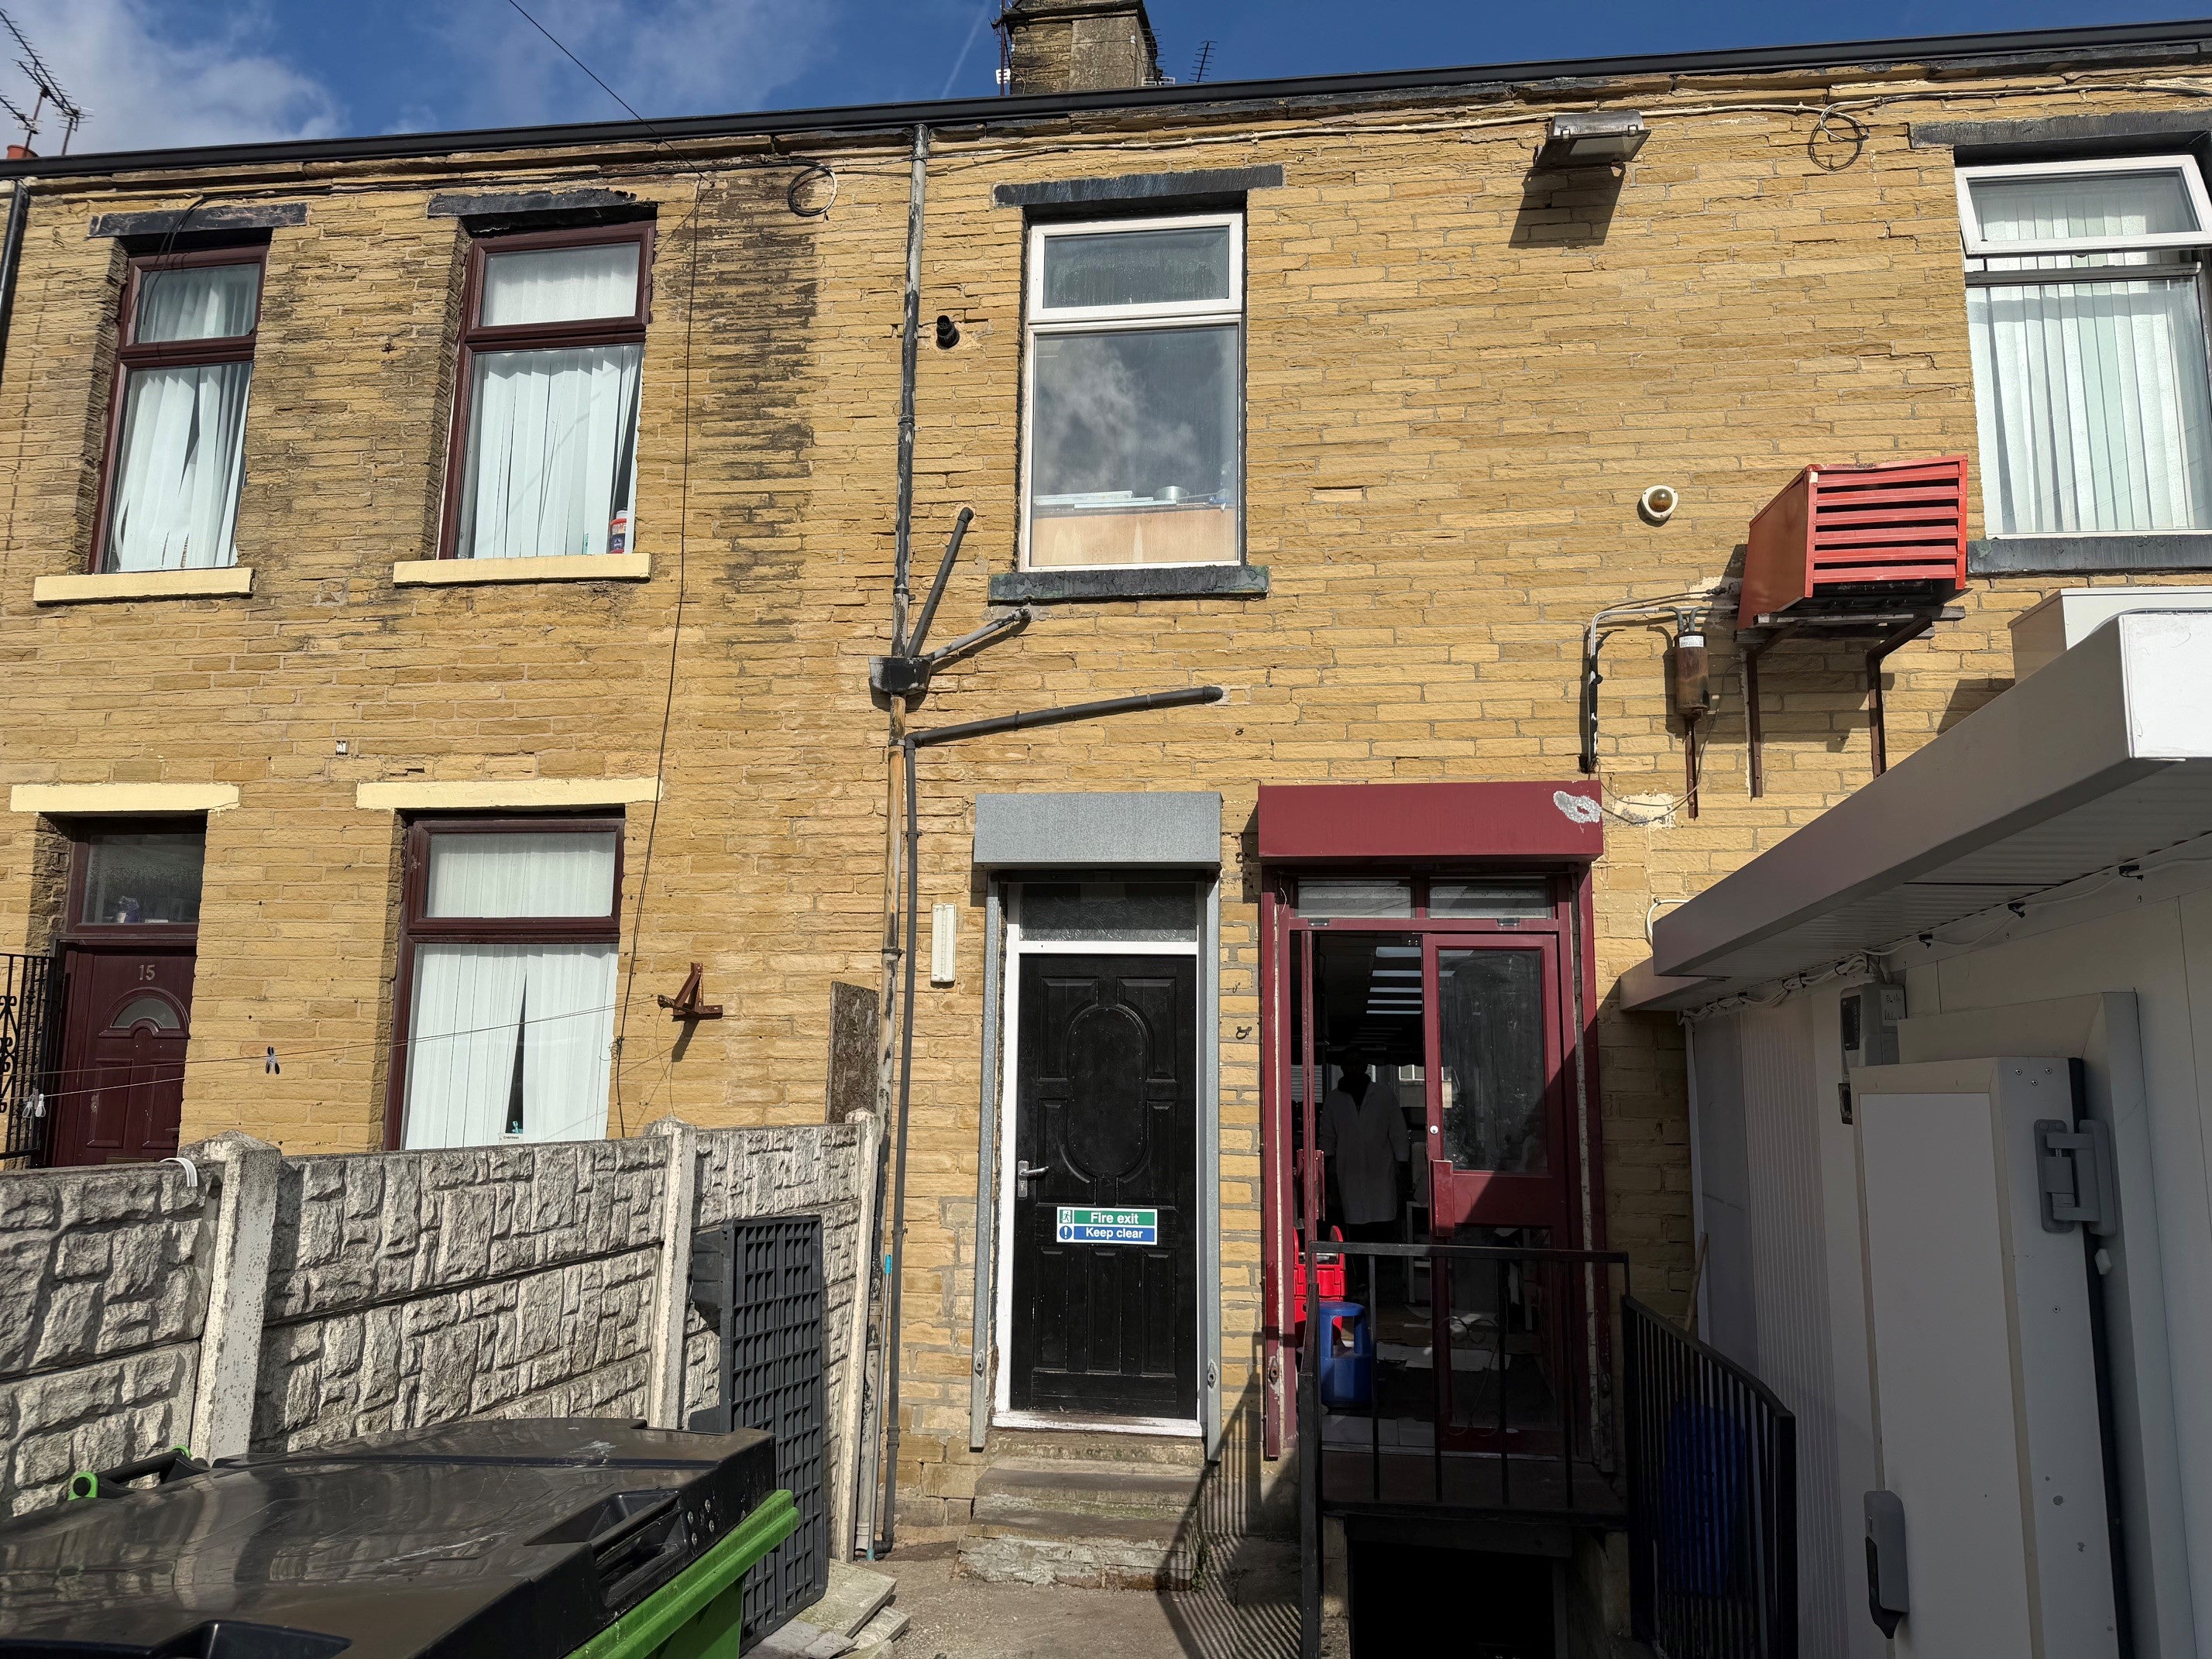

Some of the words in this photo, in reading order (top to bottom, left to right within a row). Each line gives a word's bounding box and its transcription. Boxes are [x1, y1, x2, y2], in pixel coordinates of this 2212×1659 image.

[139, 964, 156, 981] 15
[1091, 1212, 1114, 1224] Fire
[1117, 1213, 1139, 1224] exit
[1086, 1227, 1114, 1239] Keep
[1116, 1228, 1143, 1238] clear
